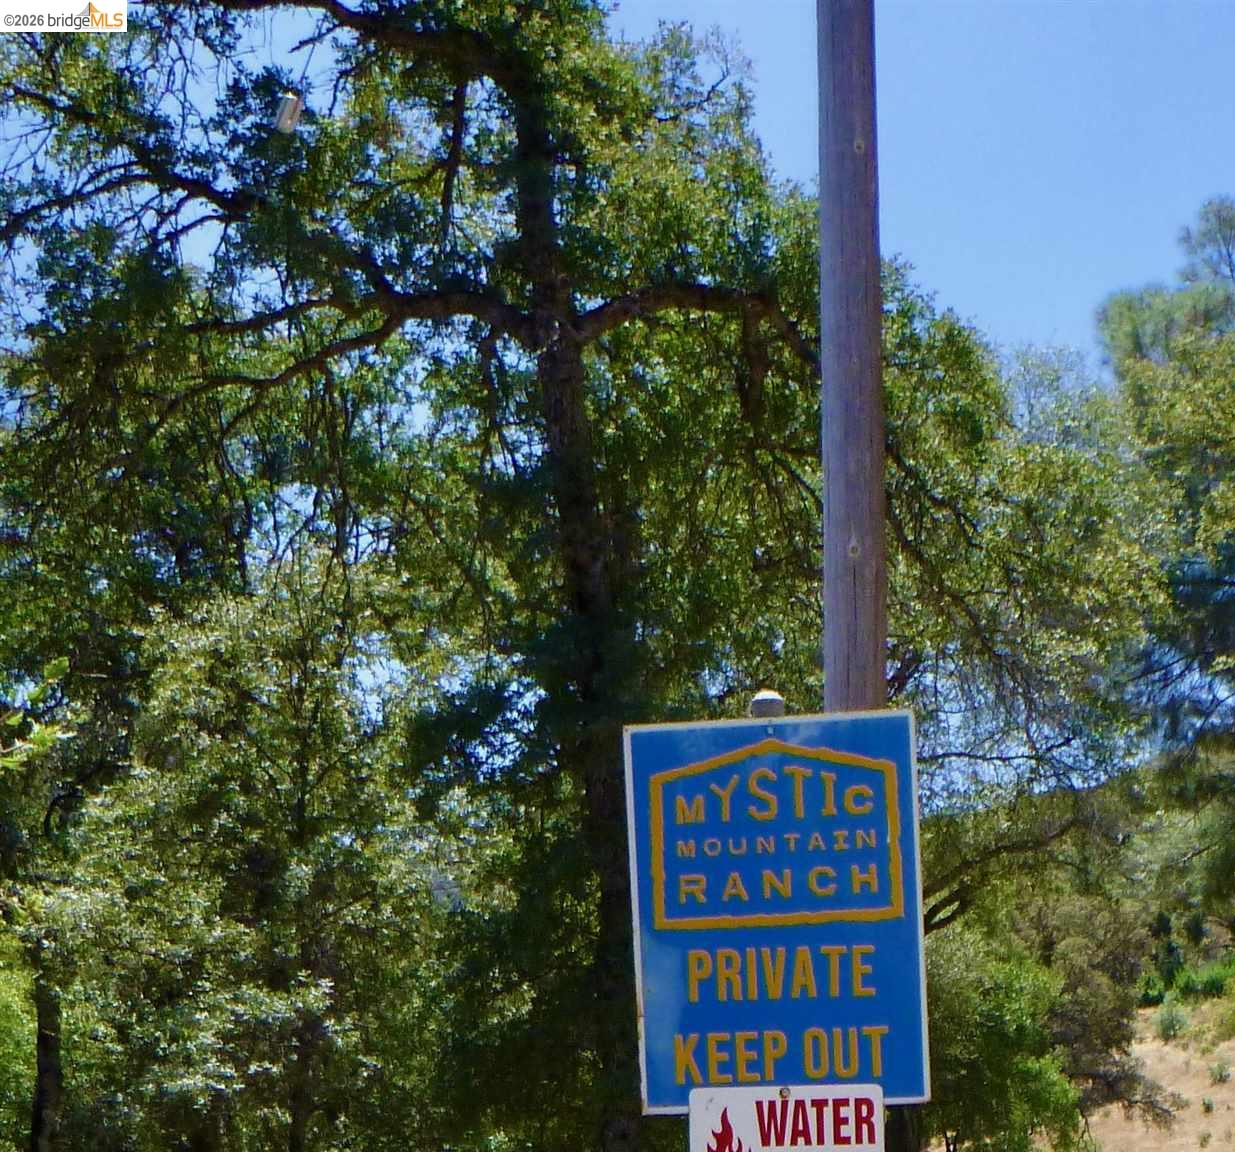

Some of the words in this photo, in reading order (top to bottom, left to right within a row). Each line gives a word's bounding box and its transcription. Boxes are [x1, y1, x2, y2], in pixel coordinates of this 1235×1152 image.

[675, 766, 874, 824] MYSTIC
[677, 829, 877, 858] MOUNTAIN
[679, 864, 879, 904] RANCH
[687, 945, 876, 1003] PRIVATE
[674, 1030, 787, 1085] KEEP
[804, 1026, 889, 1080] OUT
[755, 1097, 876, 1147] WATER
